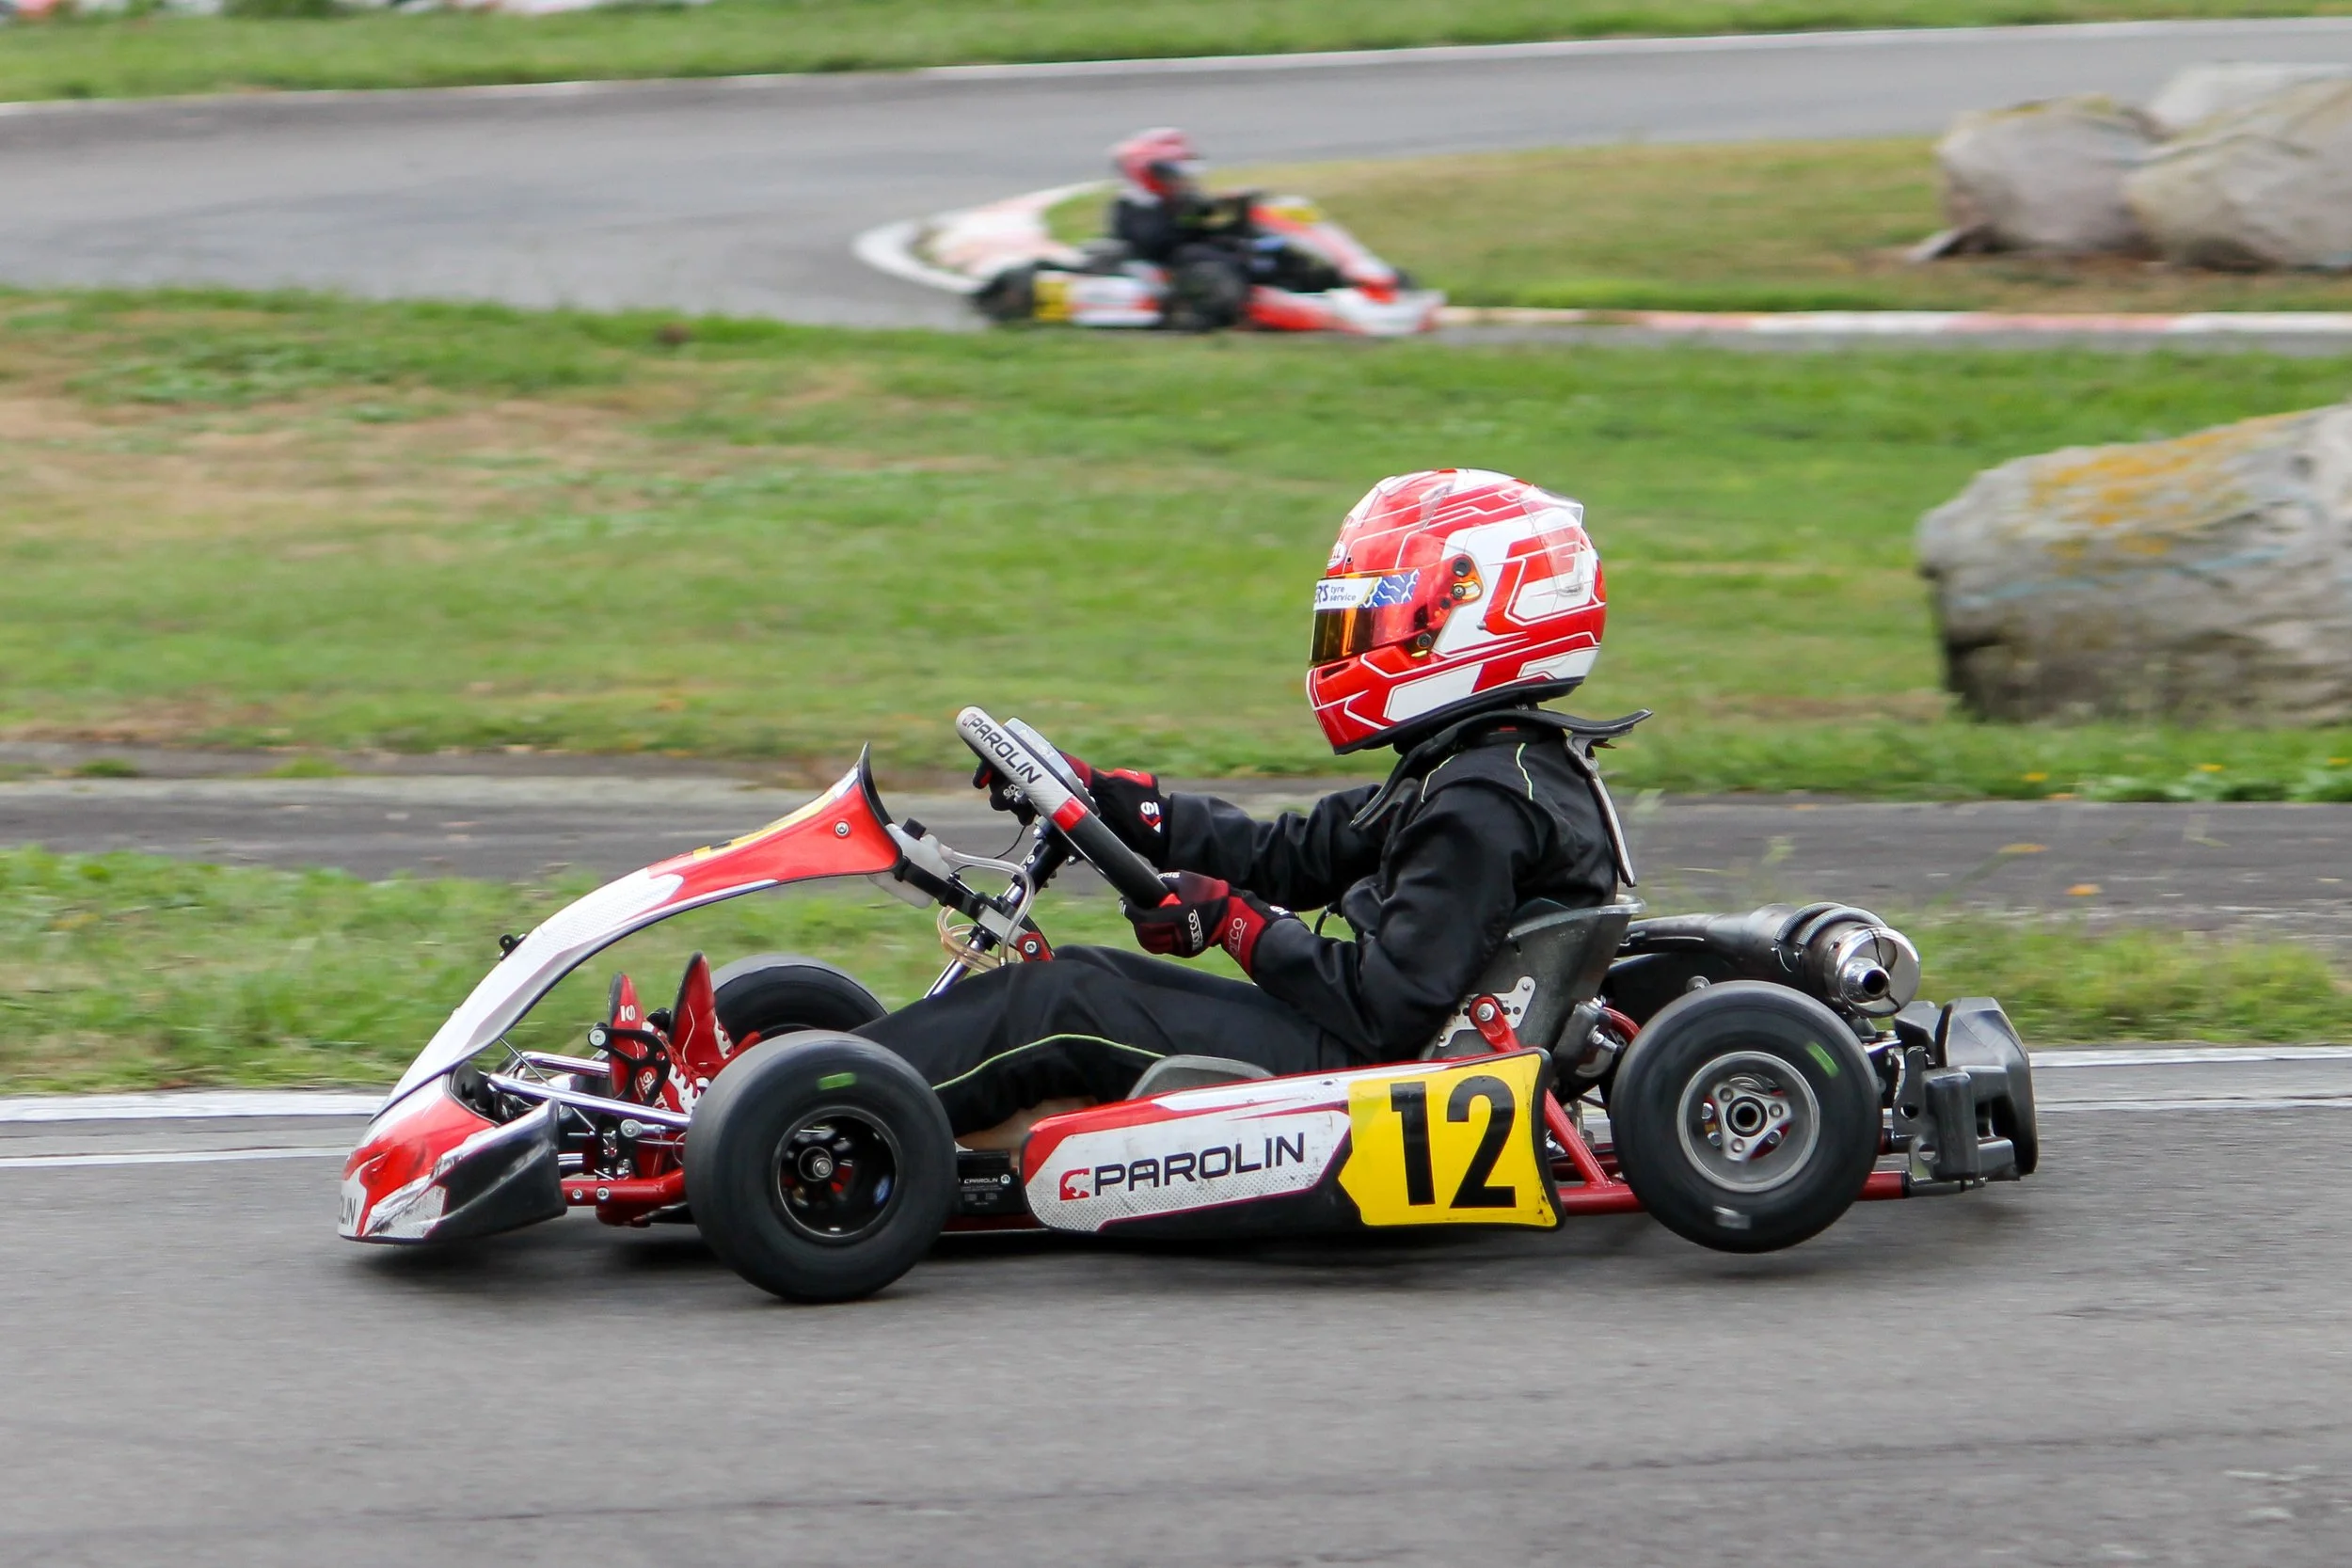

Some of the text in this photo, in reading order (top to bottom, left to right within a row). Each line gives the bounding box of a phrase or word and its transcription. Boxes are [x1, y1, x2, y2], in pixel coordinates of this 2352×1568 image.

[1329, 593, 1357, 602] service
[1330, 585, 1345, 594] tyre
[966, 718, 1042, 784] PAROLIN
[1094, 1132, 1305, 1196] PAROLIN
[1391, 1075, 1517, 1209] 12
